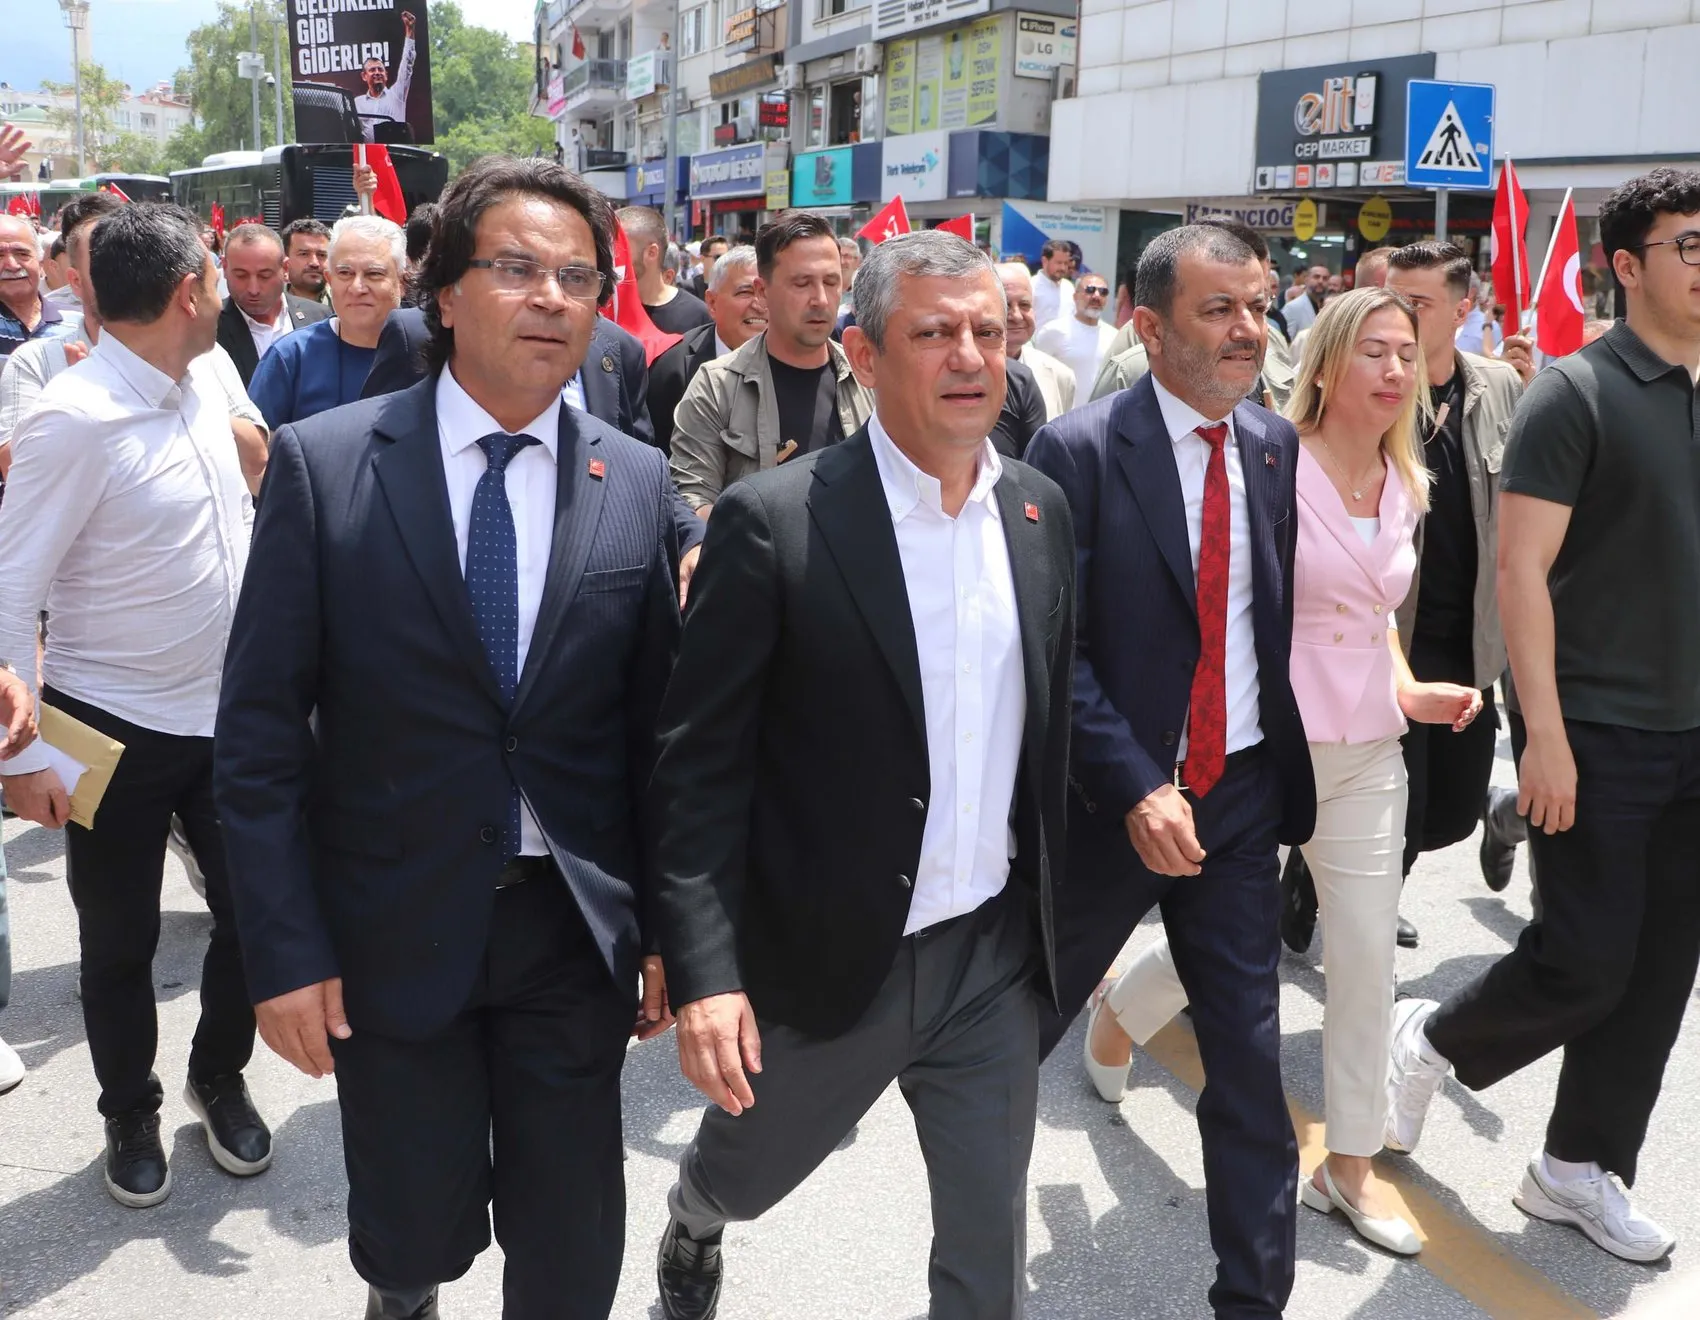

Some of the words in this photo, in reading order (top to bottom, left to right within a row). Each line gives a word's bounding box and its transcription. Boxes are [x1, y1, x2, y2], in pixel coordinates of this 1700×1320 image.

[296, 13, 335, 46] GİBİ
[1029, 21, 1054, 33] iPhone
[1037, 43, 1053, 55] LG
[298, 41, 390, 76] GİDERLER!
[1295, 143, 1318, 158] CEP
[1321, 139, 1368, 155] MARKET
[886, 164, 899, 177] Türk
[901, 163, 926, 175] Telekom
